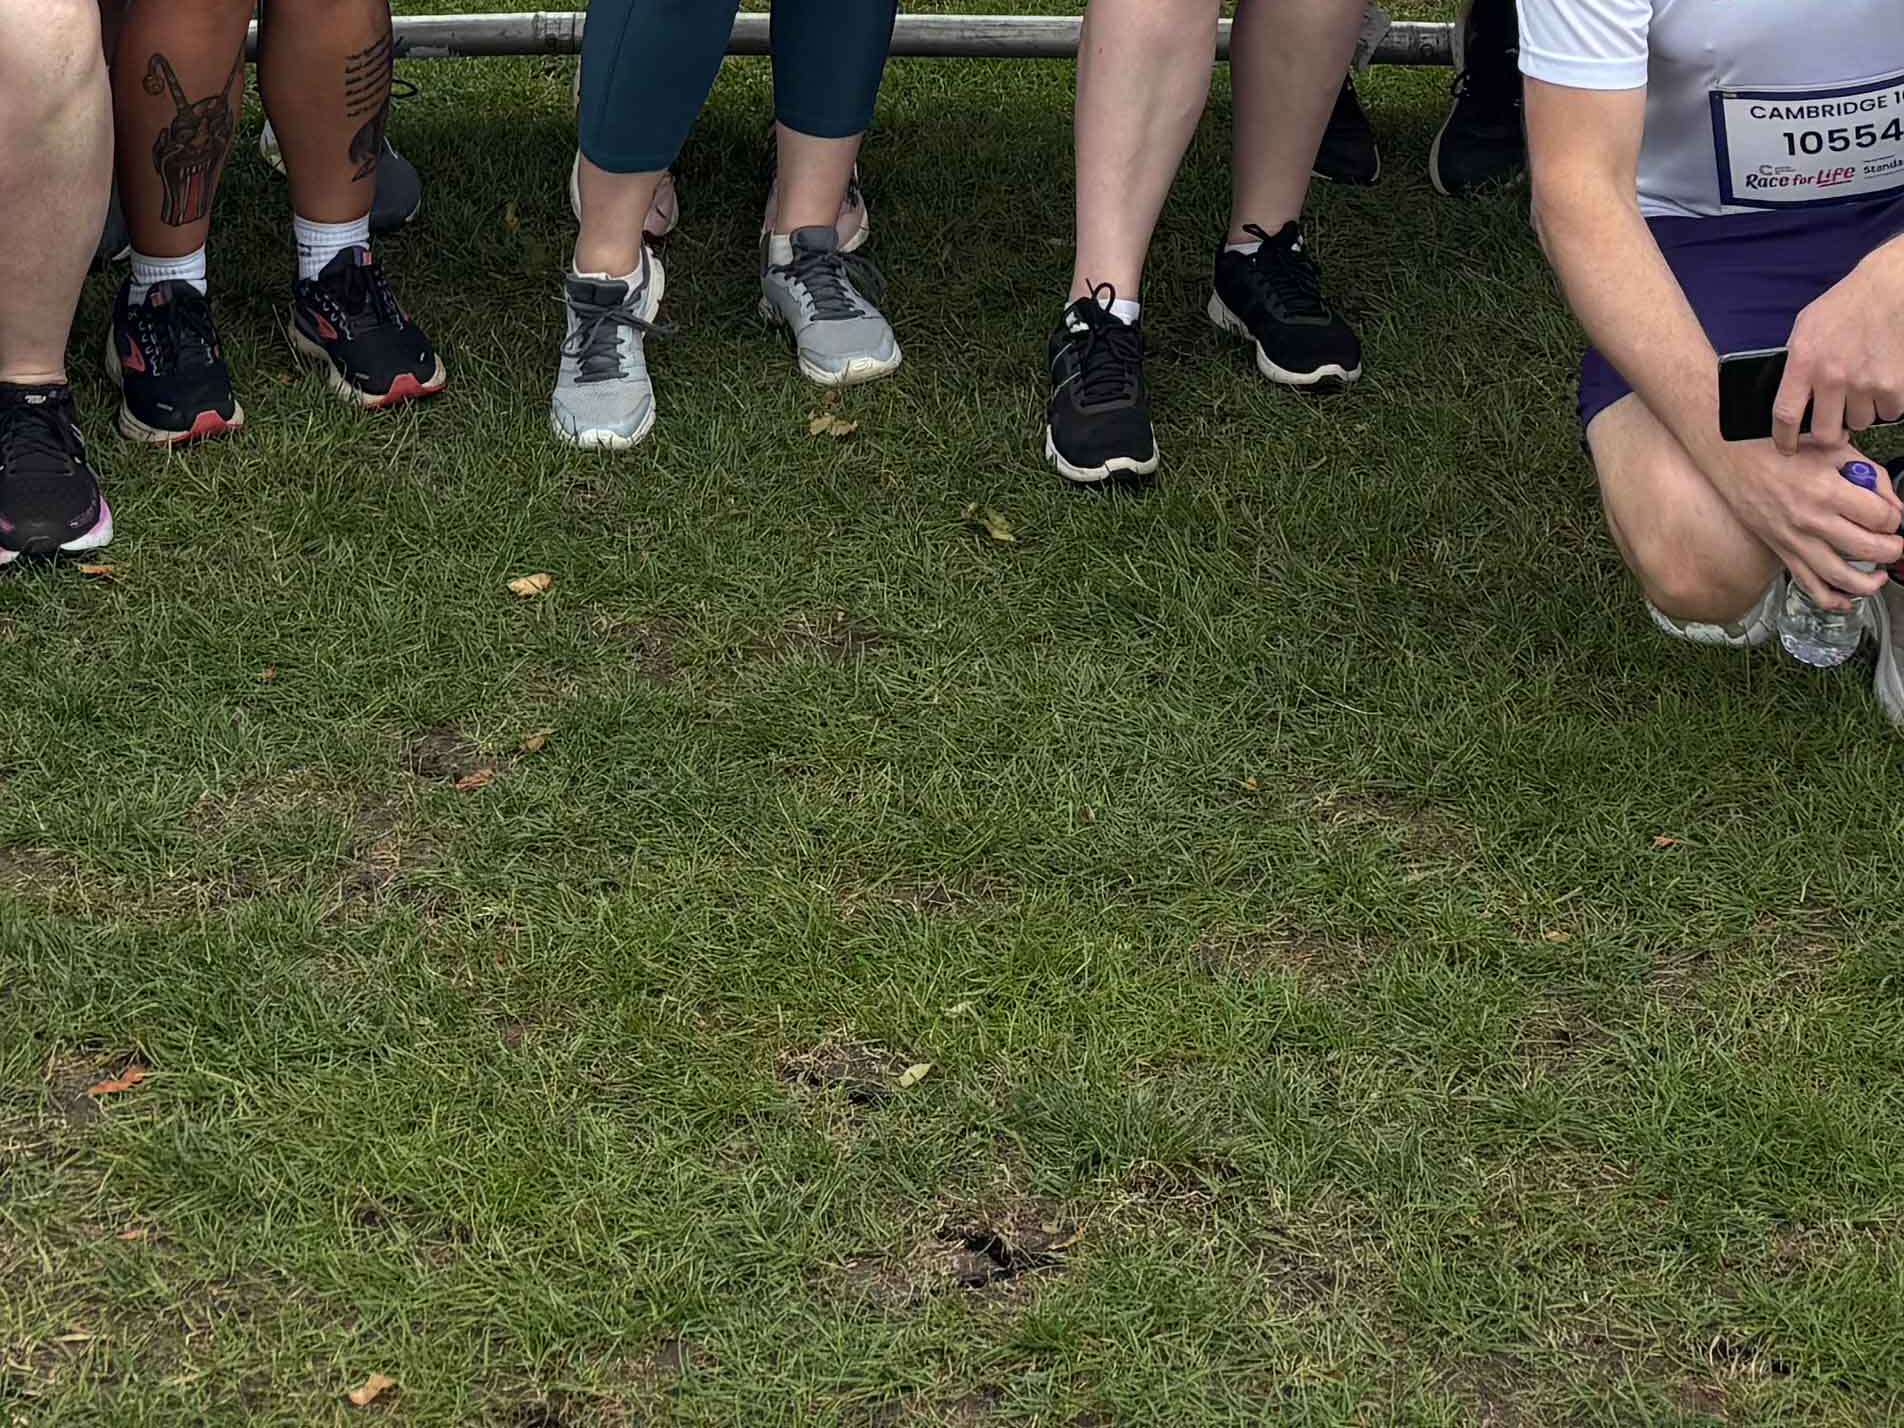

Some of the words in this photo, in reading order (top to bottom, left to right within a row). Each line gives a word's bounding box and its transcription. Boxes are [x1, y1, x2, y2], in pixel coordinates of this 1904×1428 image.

[1750, 95, 1888, 120] CAMBRIDGE
[1783, 118, 1904, 156] 10554
[1746, 172, 1789, 190] Race
[1792, 173, 1816, 186] for
[1815, 166, 1855, 185] Life
